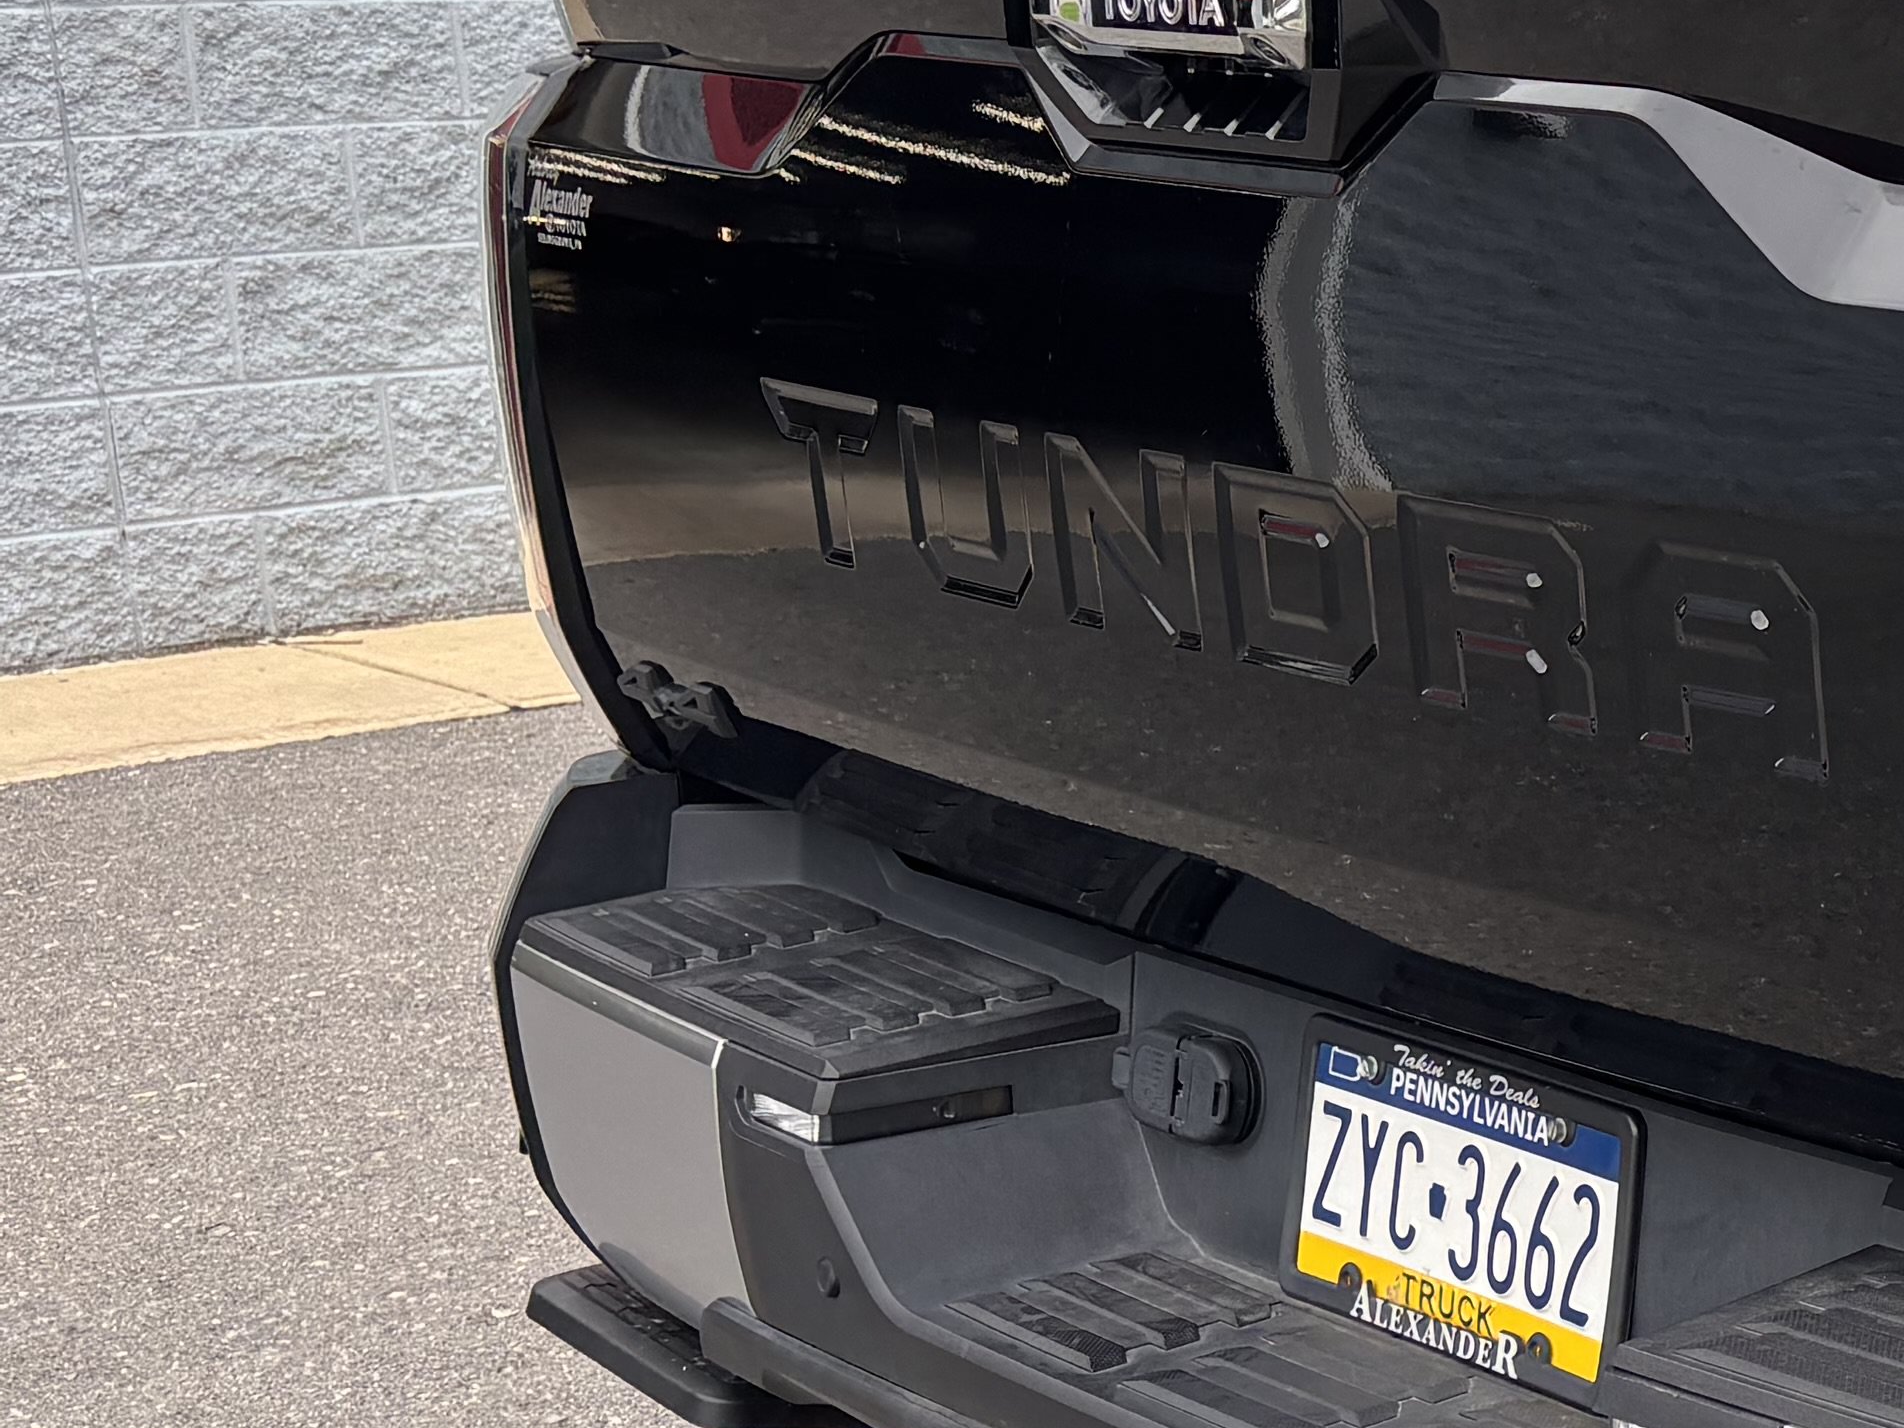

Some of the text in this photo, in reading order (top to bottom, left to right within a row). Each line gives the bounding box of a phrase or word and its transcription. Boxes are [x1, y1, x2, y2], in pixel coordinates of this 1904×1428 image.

[760, 376, 1830, 782] TUNDRA
[1389, 1066, 1549, 1147] PENNSYLVANIA
[1393, 1044, 1541, 1108] Takin' the Deals
[1349, 1280, 1519, 1380] ALEXANDER
[1402, 1272, 1496, 1338] TRUCK
